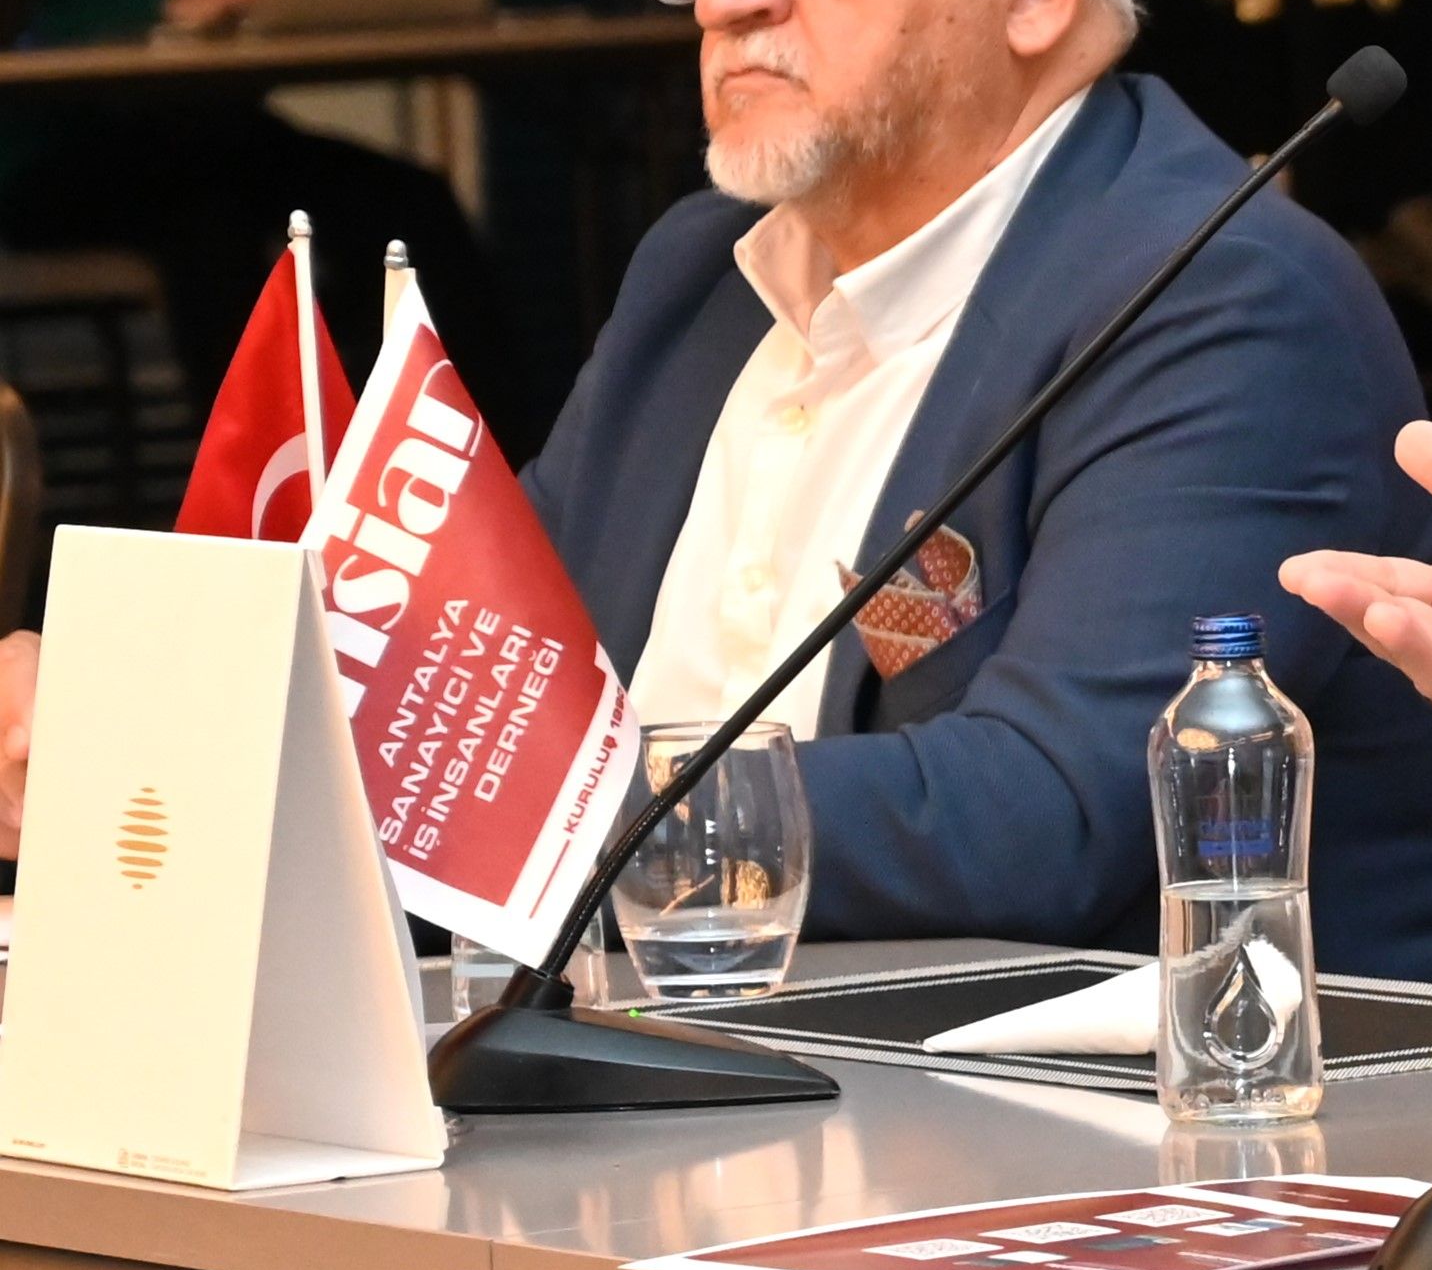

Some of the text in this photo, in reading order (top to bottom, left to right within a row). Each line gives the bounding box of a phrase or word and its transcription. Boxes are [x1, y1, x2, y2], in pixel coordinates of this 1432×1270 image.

[377, 599, 469, 768] ANTALYA
[378, 607, 502, 846] SANAYİCİ VE
[402, 624, 534, 861] İŞ İNSANLARI
[473, 636, 566, 803] DERNEĞİ
